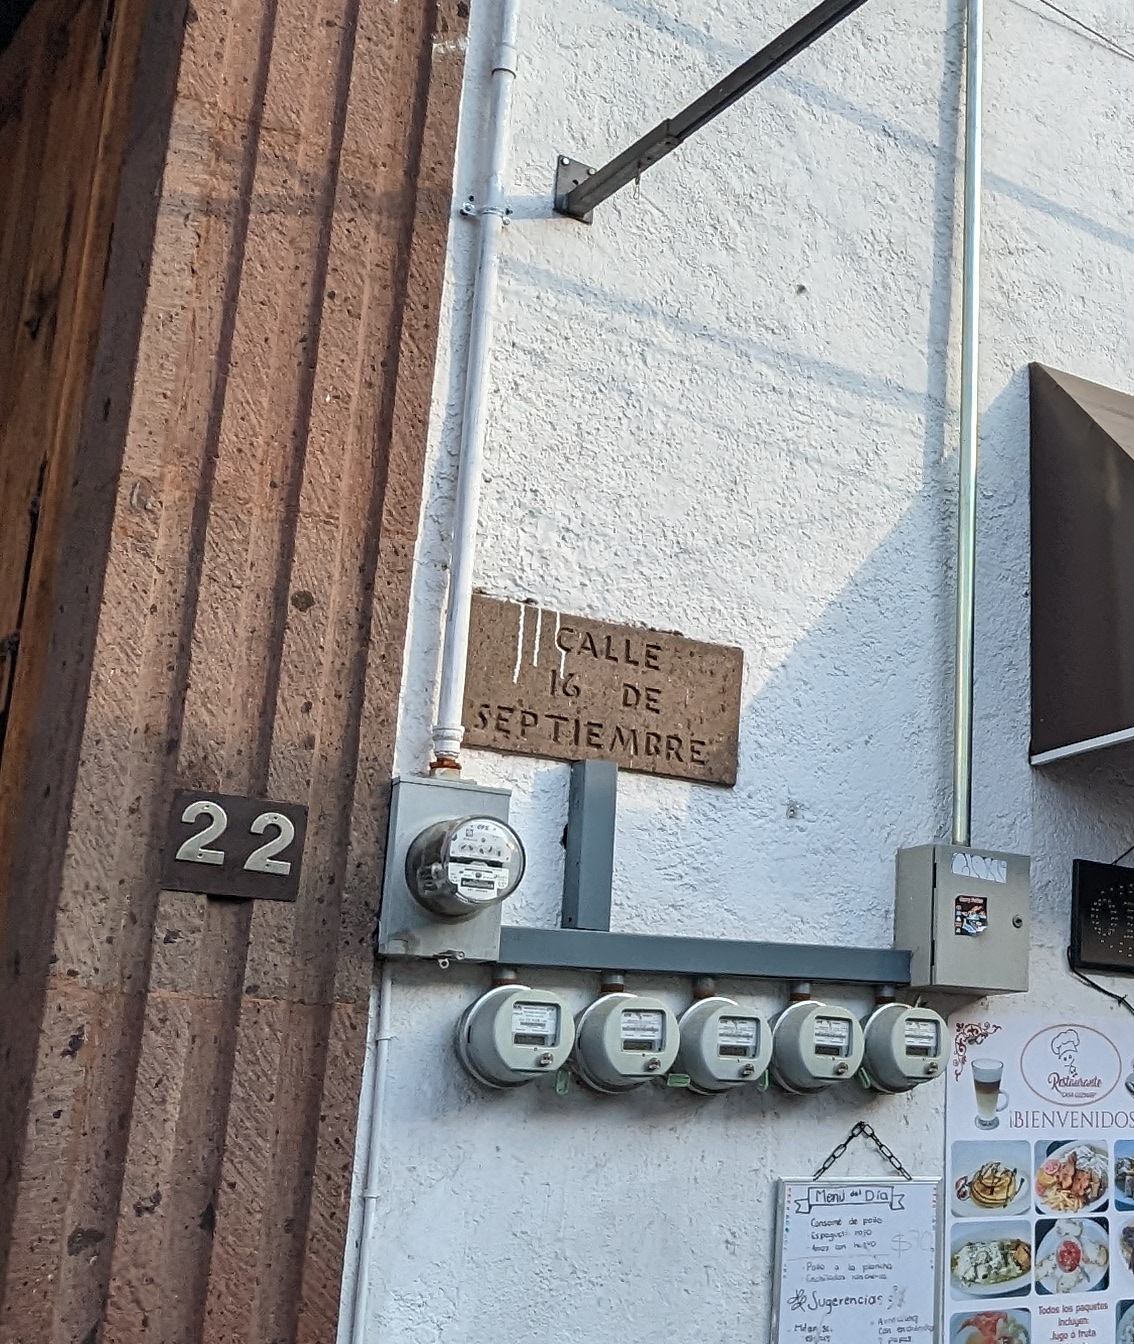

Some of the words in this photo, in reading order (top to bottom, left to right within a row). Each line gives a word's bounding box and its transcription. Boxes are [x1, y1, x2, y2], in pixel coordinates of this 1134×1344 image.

[556, 626, 662, 670] CALLE
[551, 668, 580, 698] 16
[622, 682, 662, 715] DE
[473, 703, 706, 766] SEPTIEMBRE
[175, 800, 295, 876] 22
[1038, 1305, 1060, 1315] Todos
[1061, 1304, 1073, 1313] los
[1075, 1302, 1109, 1314] paquetes
[1078, 1328, 1097, 1338] fruta
